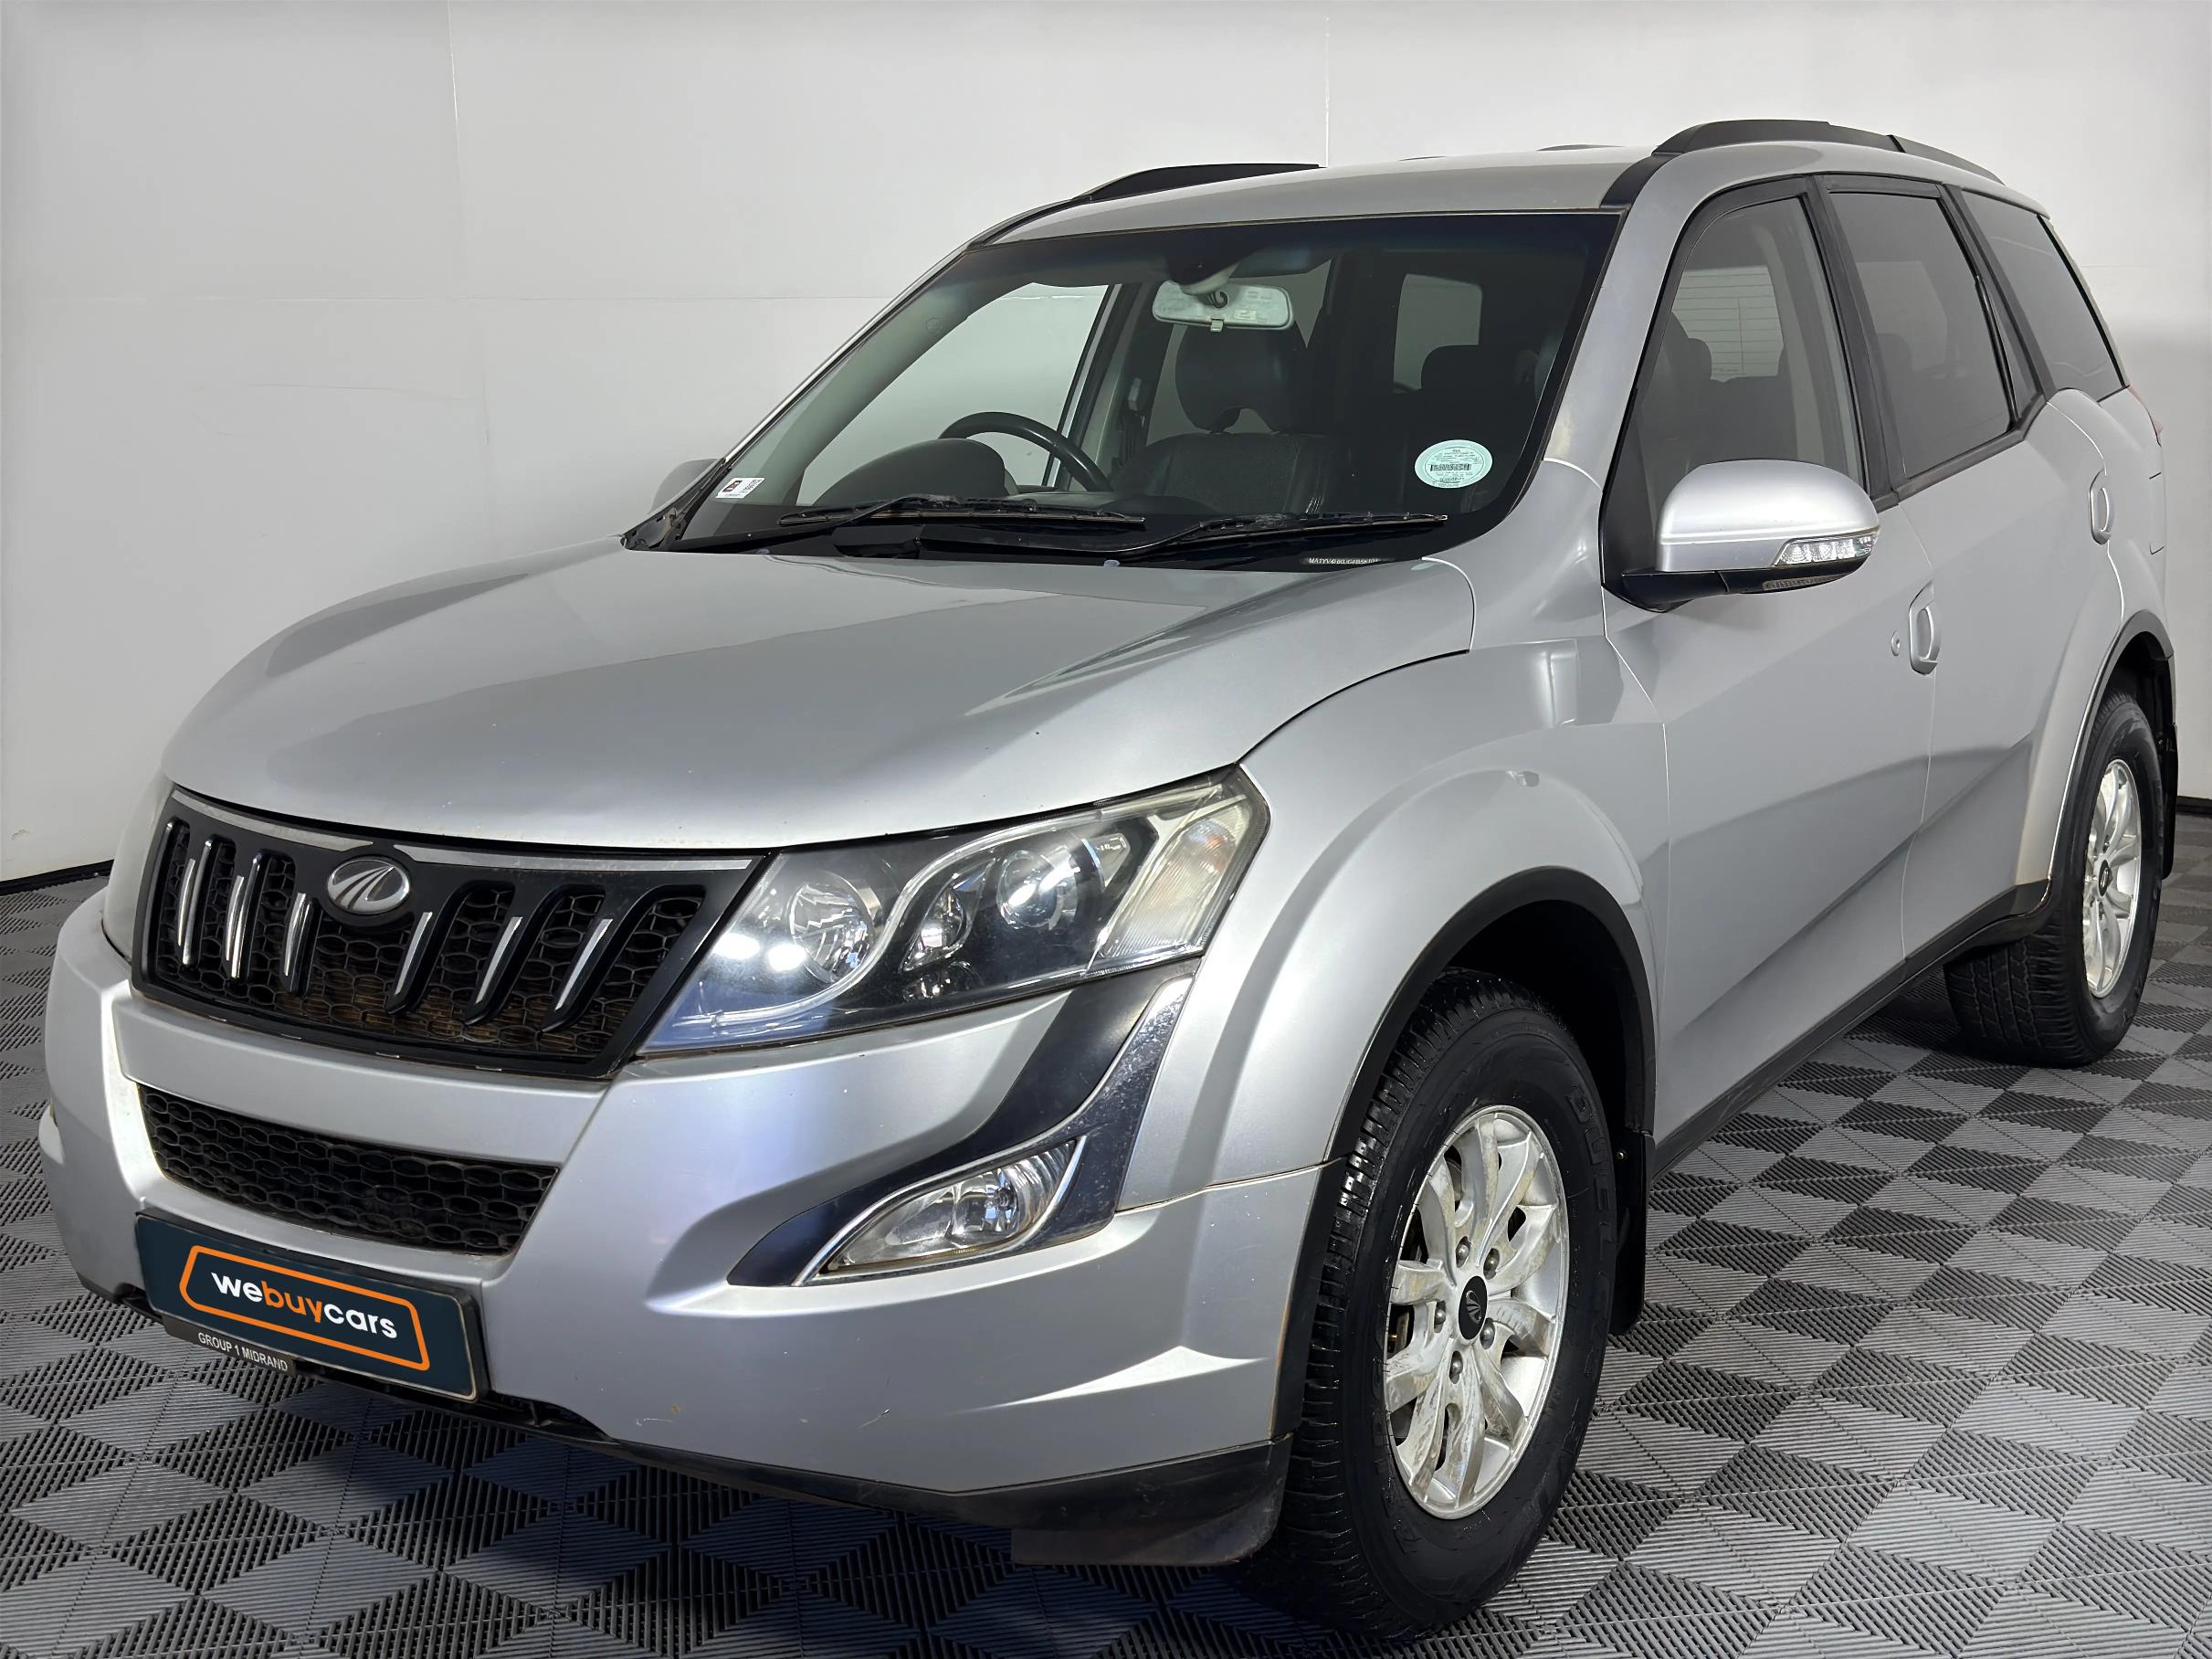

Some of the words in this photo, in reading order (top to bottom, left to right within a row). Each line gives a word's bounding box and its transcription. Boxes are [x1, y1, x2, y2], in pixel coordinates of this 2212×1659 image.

[211, 1272, 398, 1339] webuycars
[197, 1332, 233, 1353] GROUP
[235, 1344, 240, 1357] 1
[241, 1347, 289, 1372] MIDRAND
